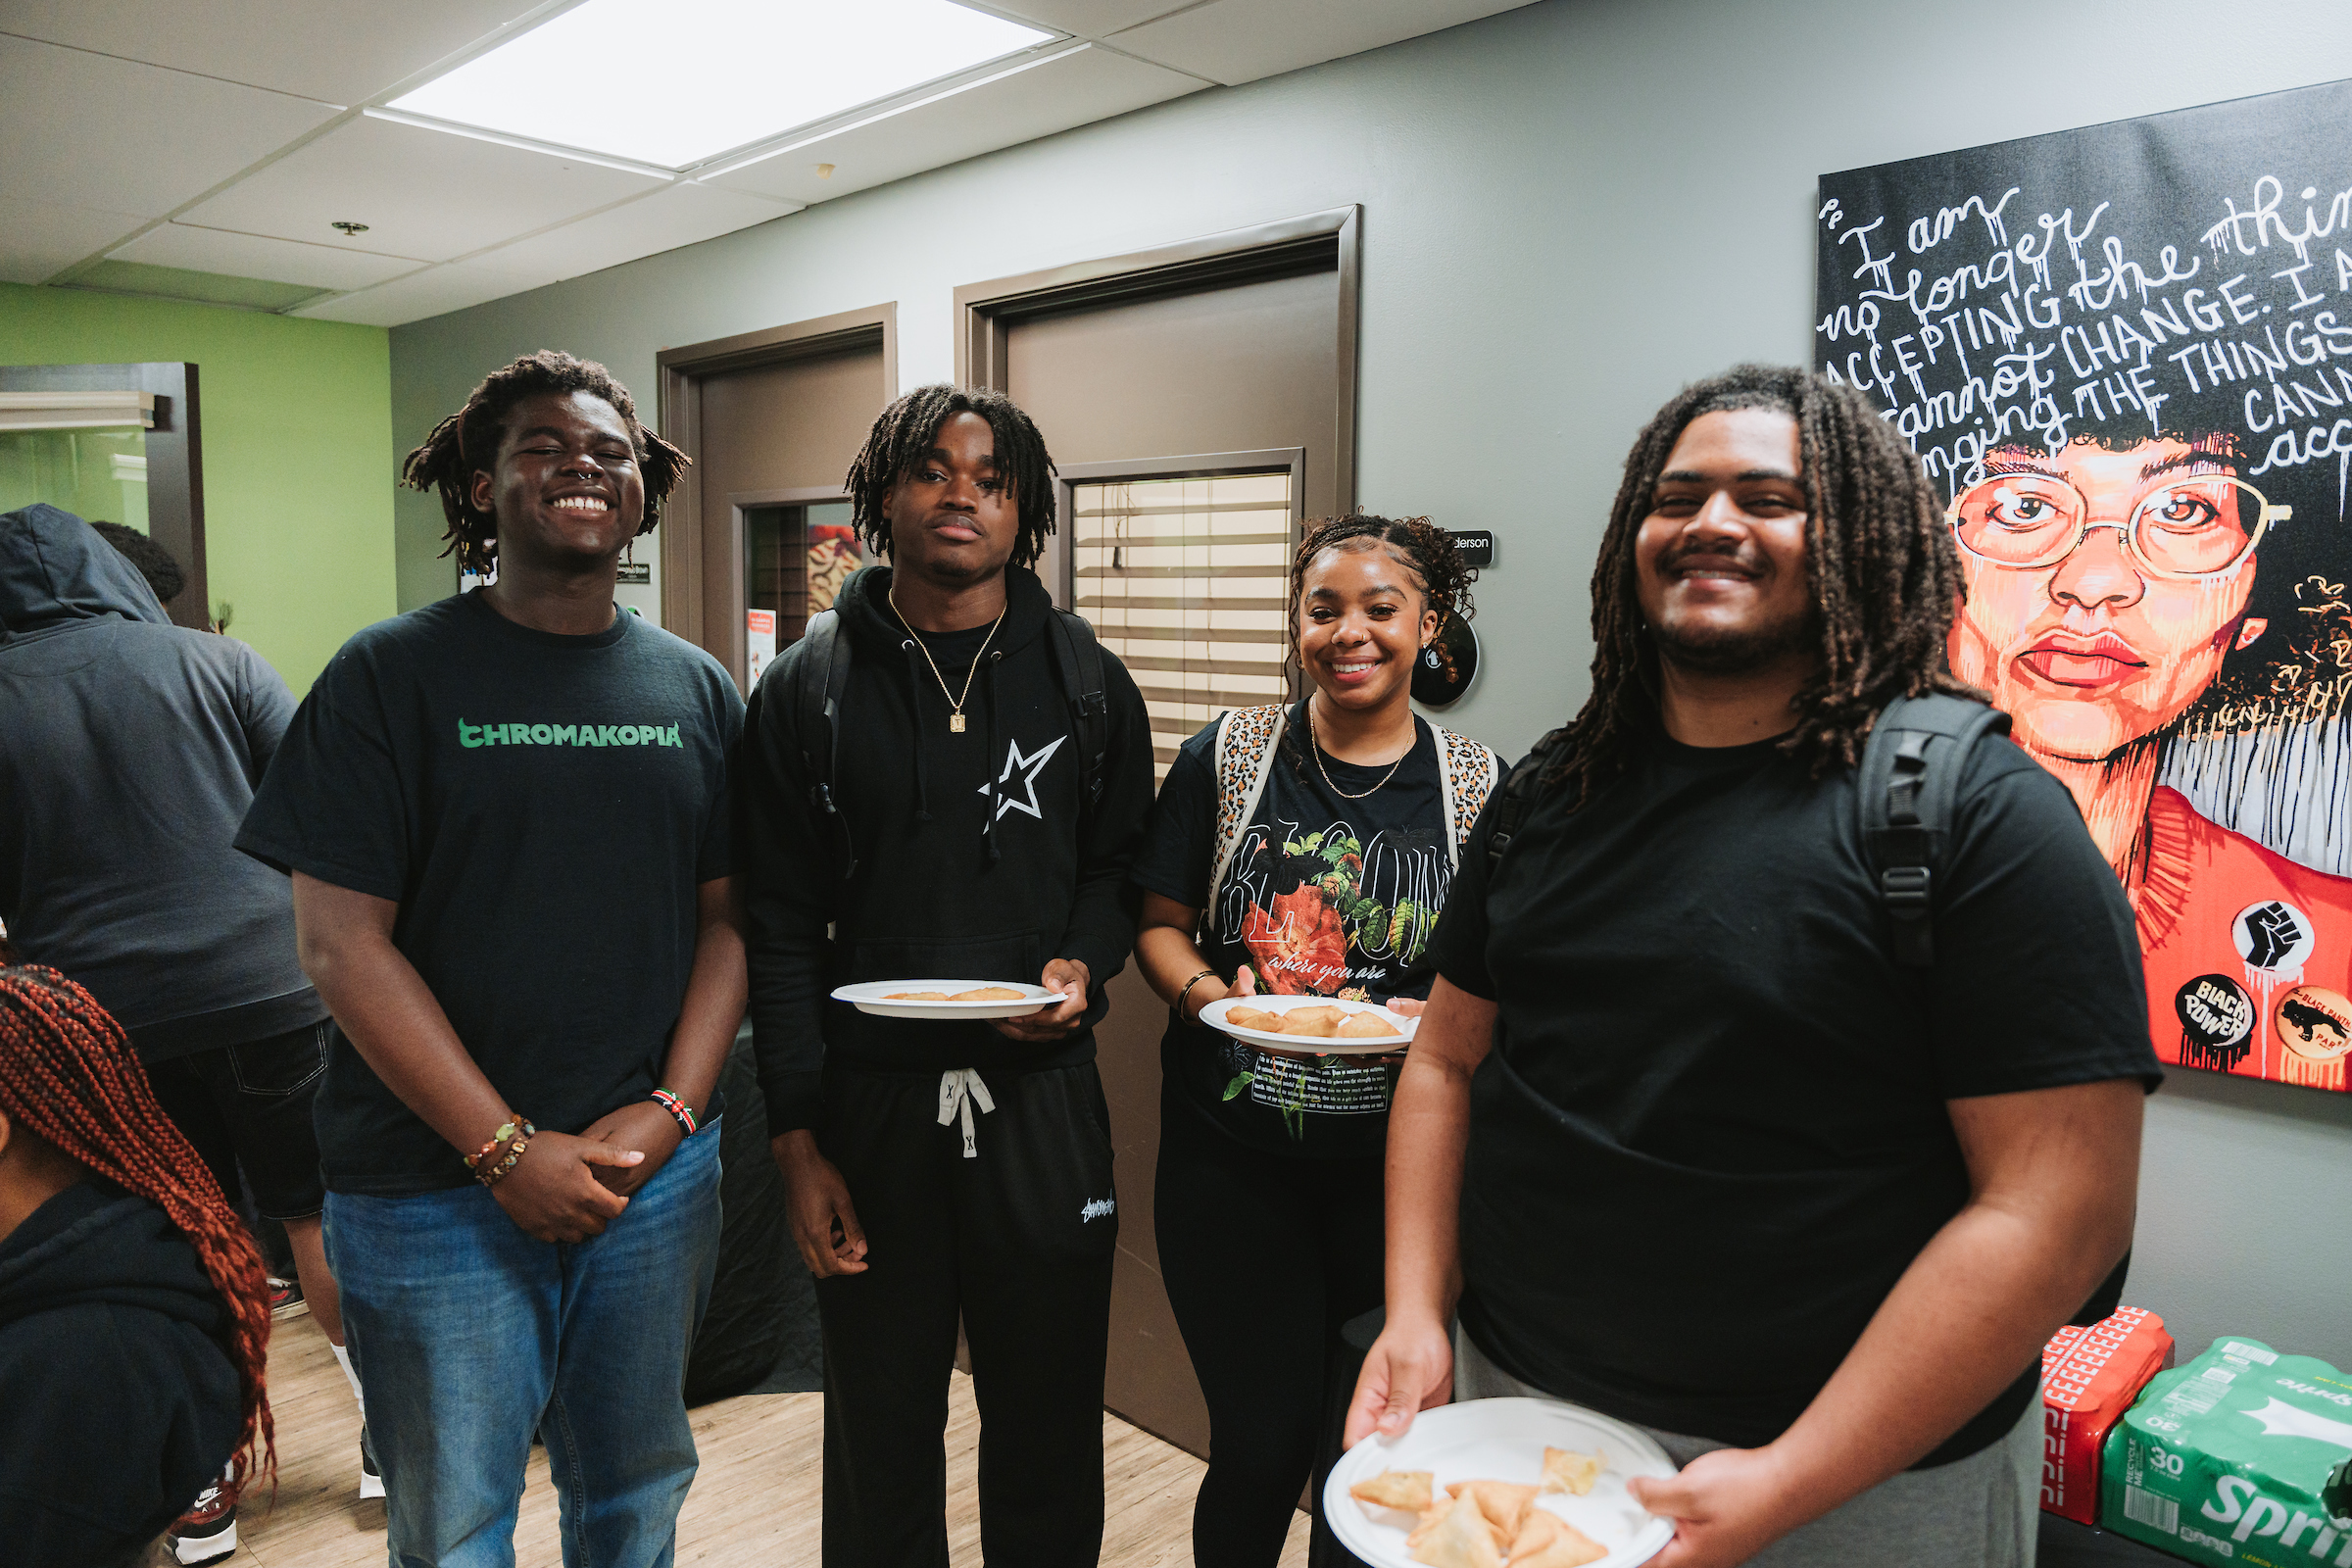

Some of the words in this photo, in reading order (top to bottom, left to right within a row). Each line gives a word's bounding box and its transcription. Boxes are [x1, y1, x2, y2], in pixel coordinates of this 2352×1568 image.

[1908, 187, 2020, 254] am
[1816, 301, 1880, 341] no
[1859, 201, 2109, 316] longer
[1827, 283, 2061, 390] ACCEPTING
[2069, 236, 2199, 312] the
[2061, 274, 2271, 378] CHANGE.
[2271, 264, 2325, 312] I
[2072, 364, 2169, 421] THE
[2168, 311, 2352, 393] THINGS
[458, 717, 684, 749] CHROMAKOPIA
[1268, 951, 1318, 973] where
[1313, 964, 1354, 987] you
[1355, 964, 1387, 980] are
[2184, 994, 2244, 1039] POWER
[2195, 980, 2246, 1021] BLACK
[2302, 994, 2327, 1013] BLACK
[2126, 1438, 2136, 1484] RECYCLE
[2133, 1470, 2143, 1487] ME
[2149, 1446, 2183, 1475] 30
[199, 1487, 219, 1500] NIKE
[202, 1502, 220, 1513] AR
